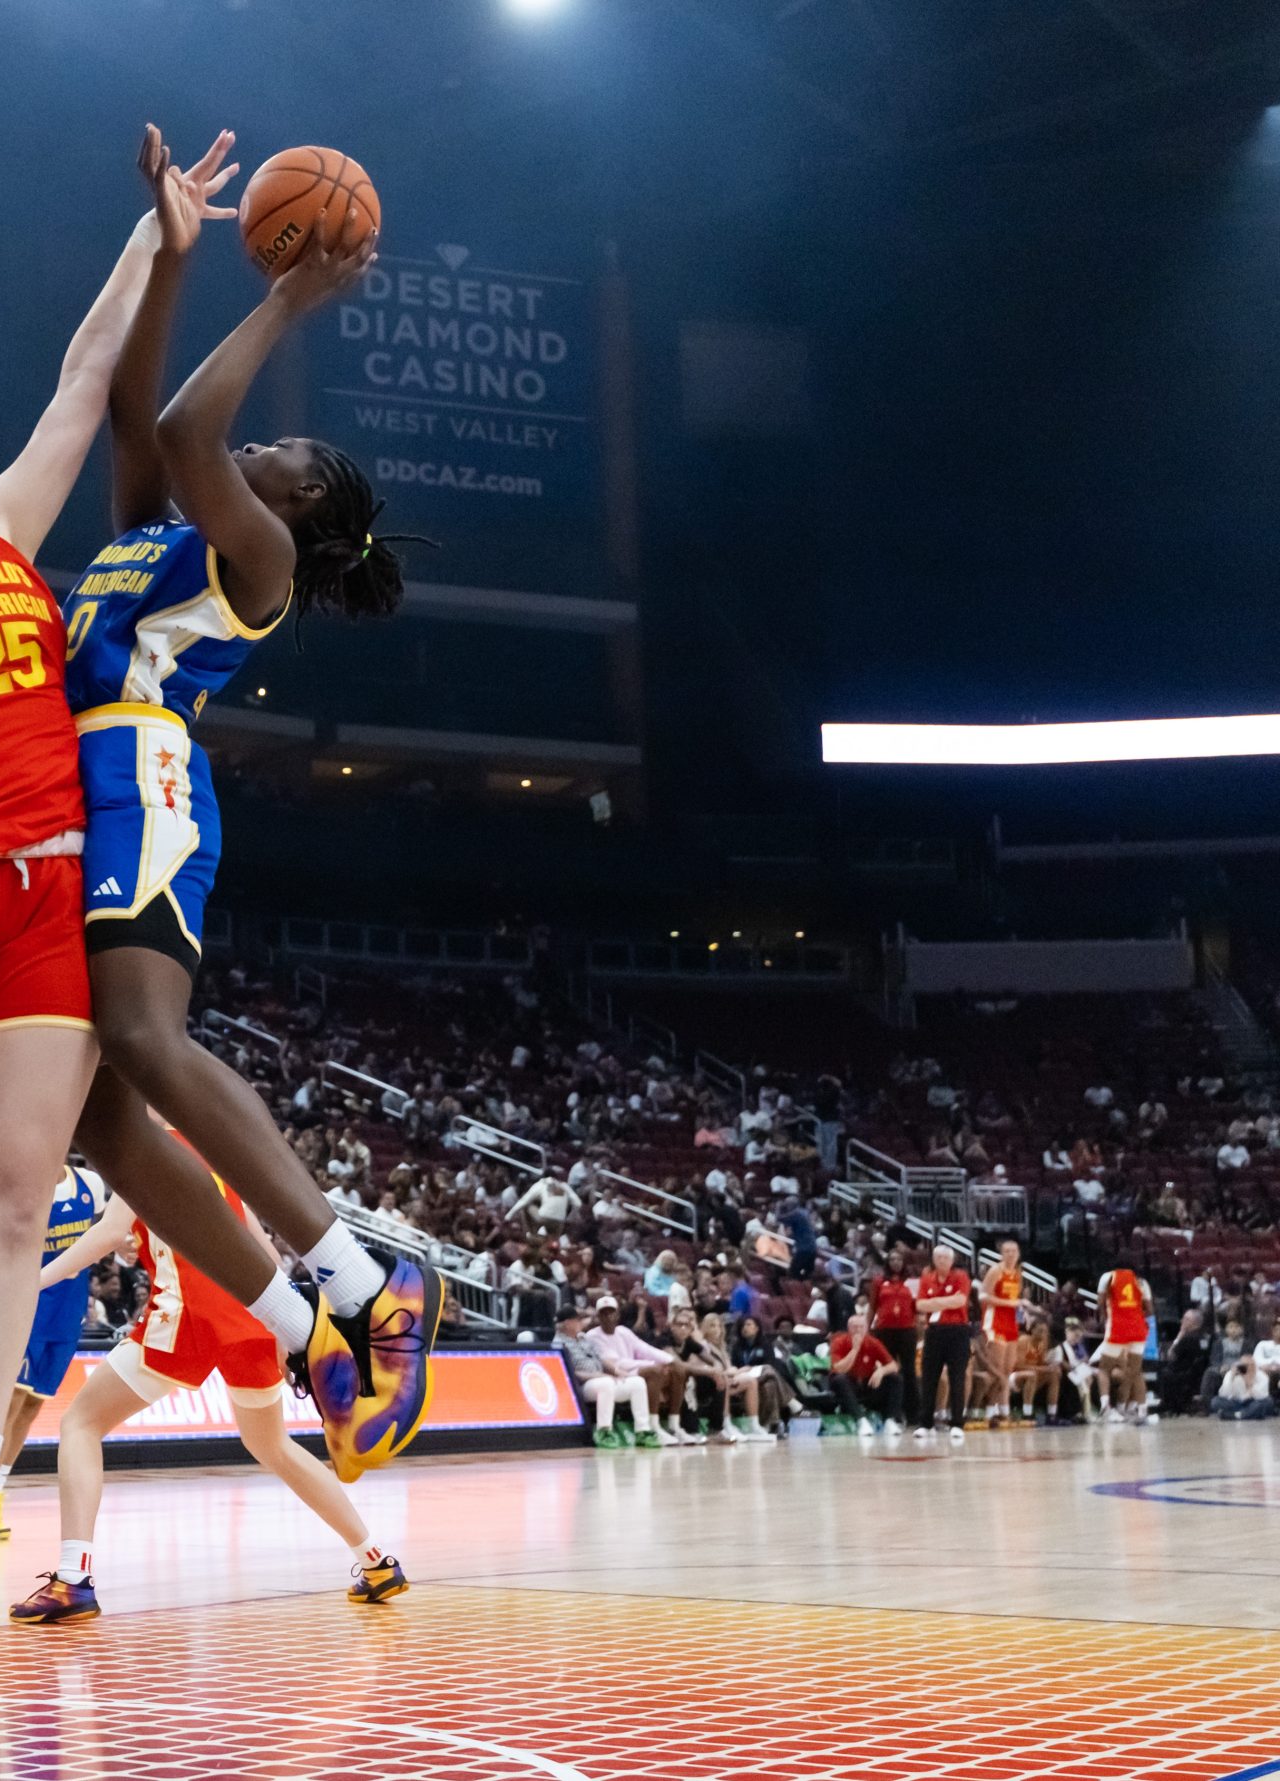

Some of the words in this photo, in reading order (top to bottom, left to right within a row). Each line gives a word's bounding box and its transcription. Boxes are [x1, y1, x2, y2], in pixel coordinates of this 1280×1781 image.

[254, 221, 304, 273] ilson
[363, 267, 543, 320] DESERT
[339, 306, 567, 364] DIAMOND
[364, 351, 546, 401] CASINO
[354, 407, 438, 436] WEST
[449, 417, 559, 450] VALLEY
[376, 458, 543, 496] DDCAZ.com
